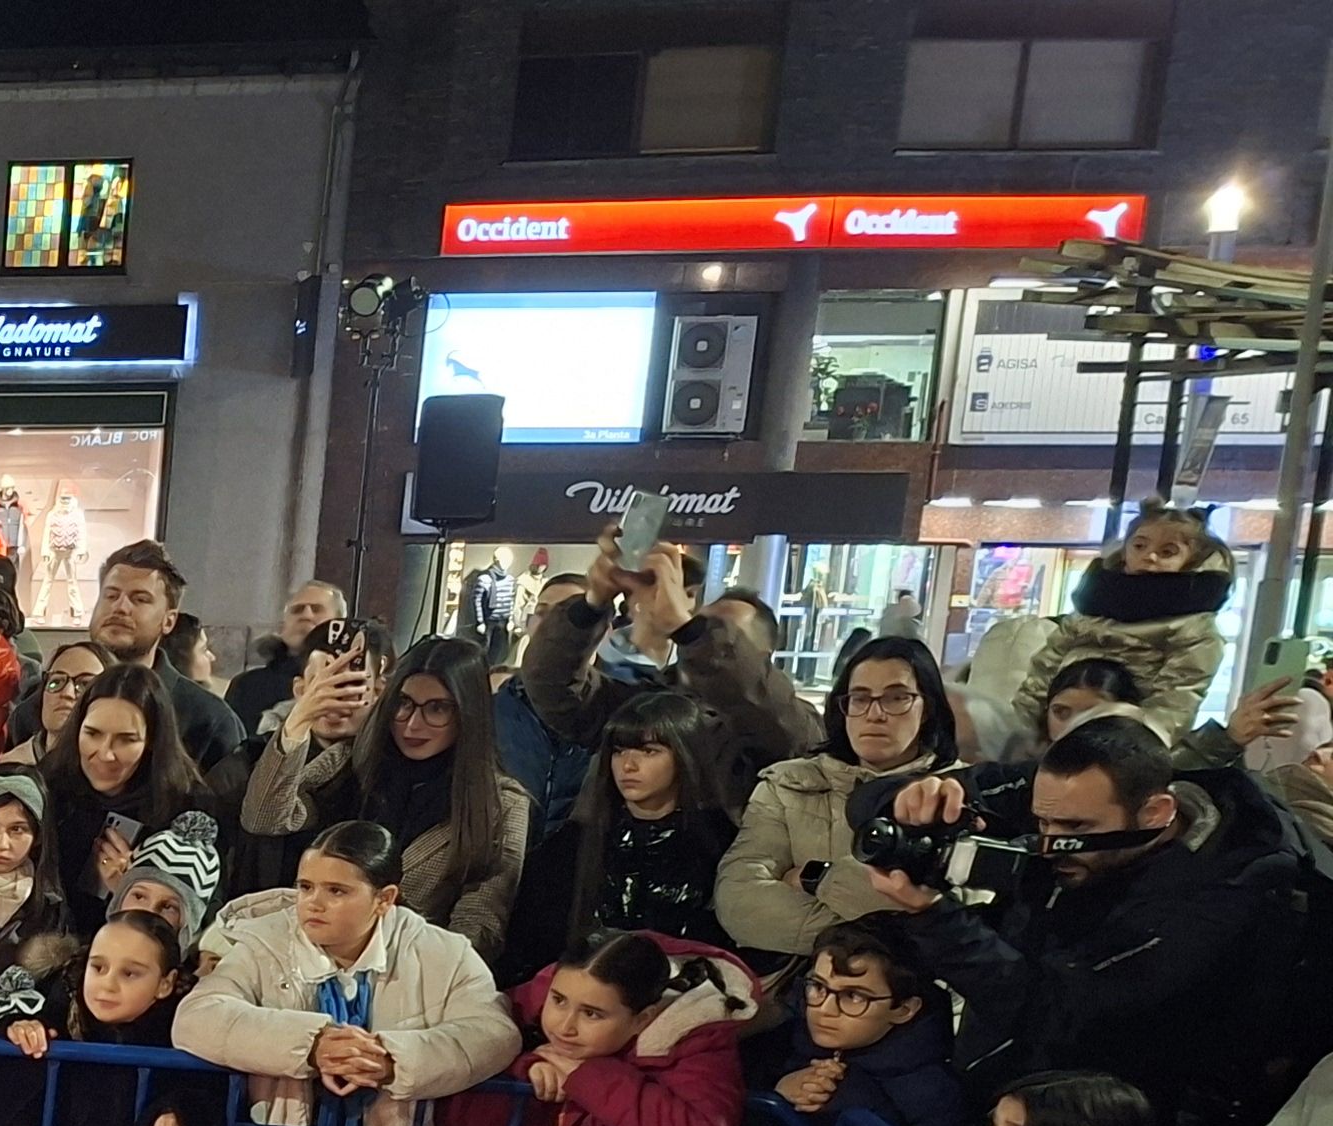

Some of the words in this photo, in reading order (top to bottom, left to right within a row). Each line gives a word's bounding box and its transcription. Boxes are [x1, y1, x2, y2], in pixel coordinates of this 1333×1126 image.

[457, 216, 570, 242] Occident
[844, 210, 959, 236] Occident
[996, 358, 1038, 369] AGISA
[1230, 413, 1250, 425] 65
[565, 481, 741, 514] Vilomat
